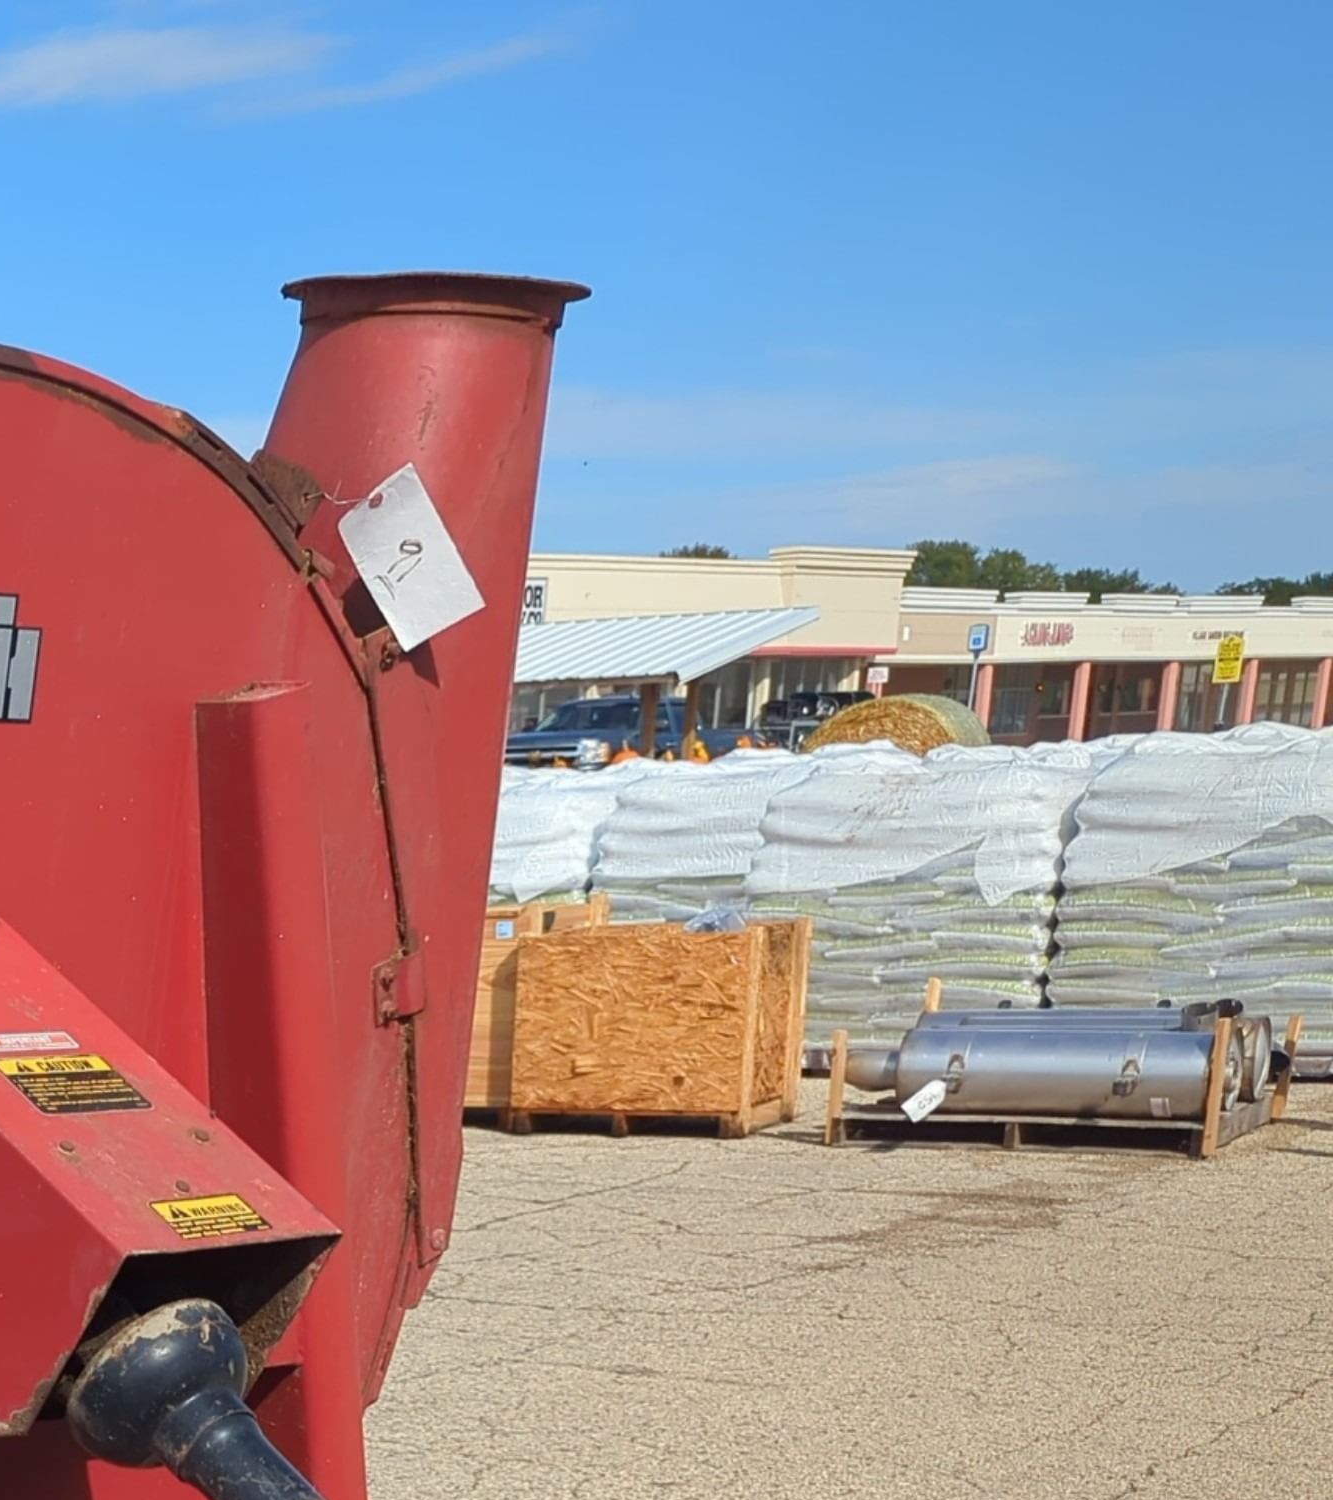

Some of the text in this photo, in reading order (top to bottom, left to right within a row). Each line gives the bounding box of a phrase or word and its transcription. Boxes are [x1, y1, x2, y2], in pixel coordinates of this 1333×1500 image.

[523, 585, 543, 608] OR
[35, 1059, 95, 1072] CAUTION
[188, 1203, 247, 1216] WARNING
